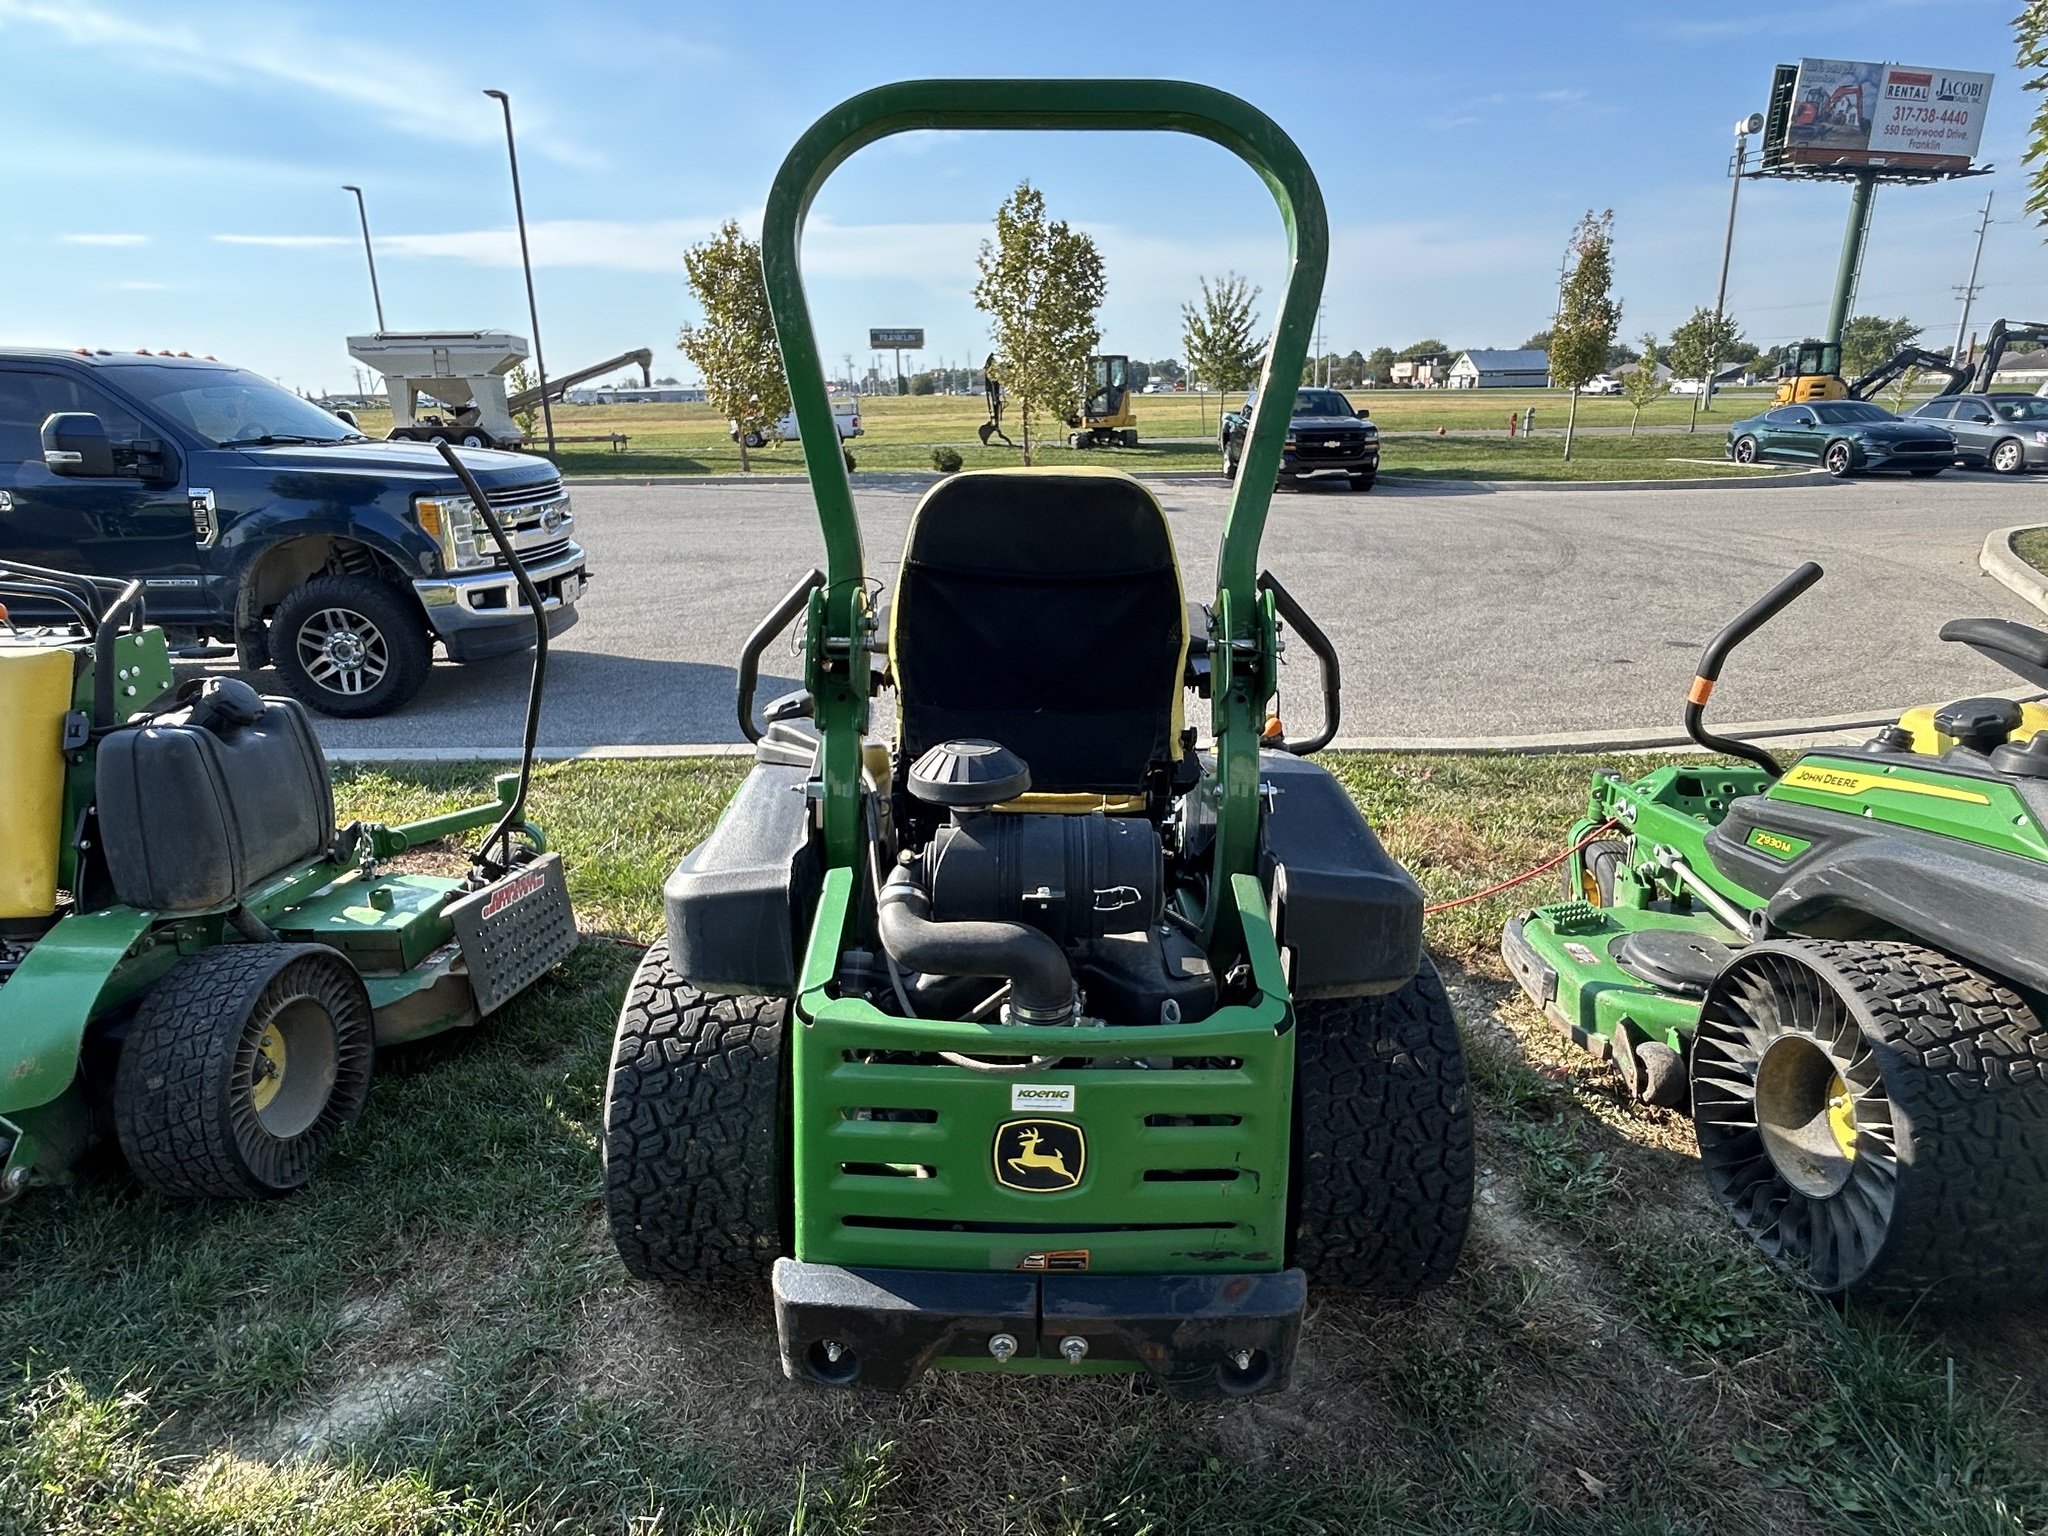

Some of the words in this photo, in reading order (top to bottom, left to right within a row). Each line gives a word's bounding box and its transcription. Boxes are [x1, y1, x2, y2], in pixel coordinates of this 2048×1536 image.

[1887, 85, 1927, 99] RENTAL
[1935, 78, 1984, 97] JACOBI
[1892, 106, 1969, 126] 317-738-4440
[1884, 124, 1899, 135] 550
[1901, 125, 1944, 139] Earlywood
[1908, 138, 1941, 150] Franklin
[1796, 769, 1823, 784] JOHN
[1823, 773, 1860, 789] DEERE
[1755, 833, 1792, 854] Z930M
